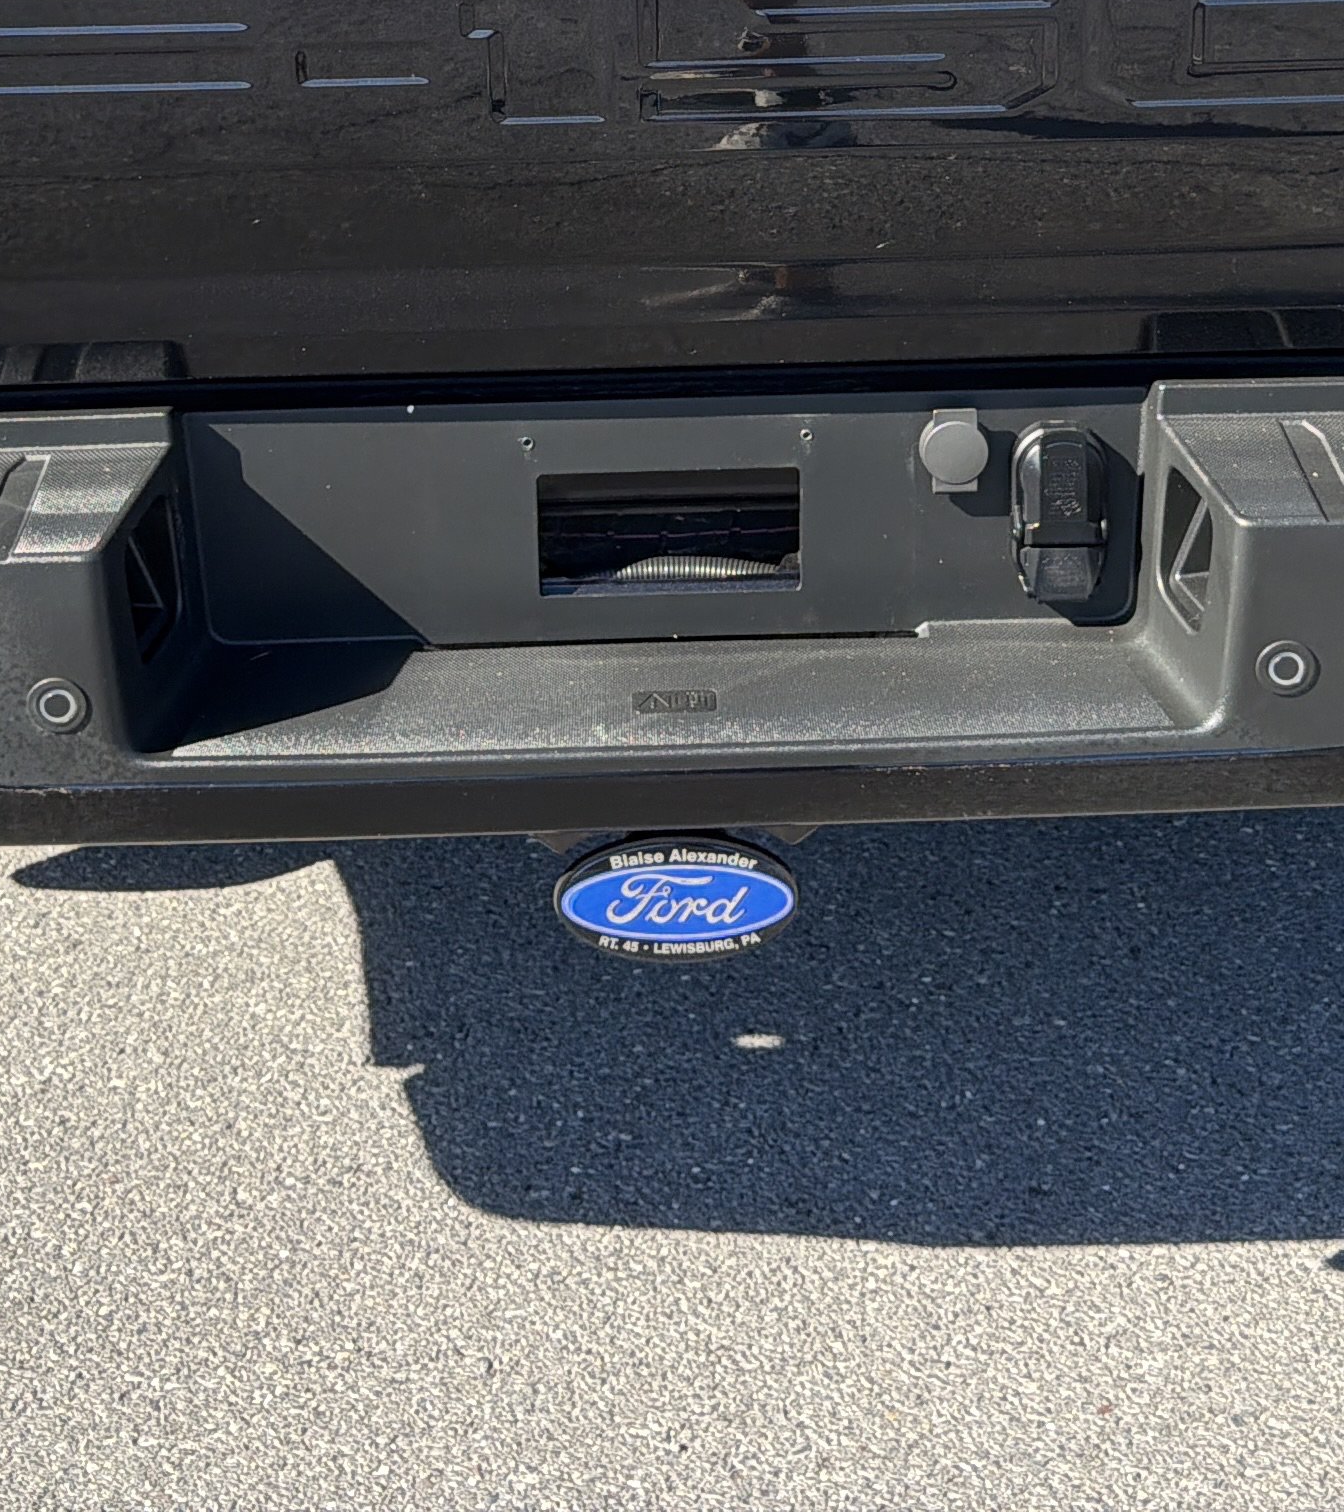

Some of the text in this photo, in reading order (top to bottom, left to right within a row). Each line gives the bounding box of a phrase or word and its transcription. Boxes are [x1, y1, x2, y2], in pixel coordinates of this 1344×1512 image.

[609, 848, 758, 870] Blaise Alexander
[606, 873, 750, 925] Ford
[598, 932, 762, 954] RT. 45 LEWISBURG, PA
